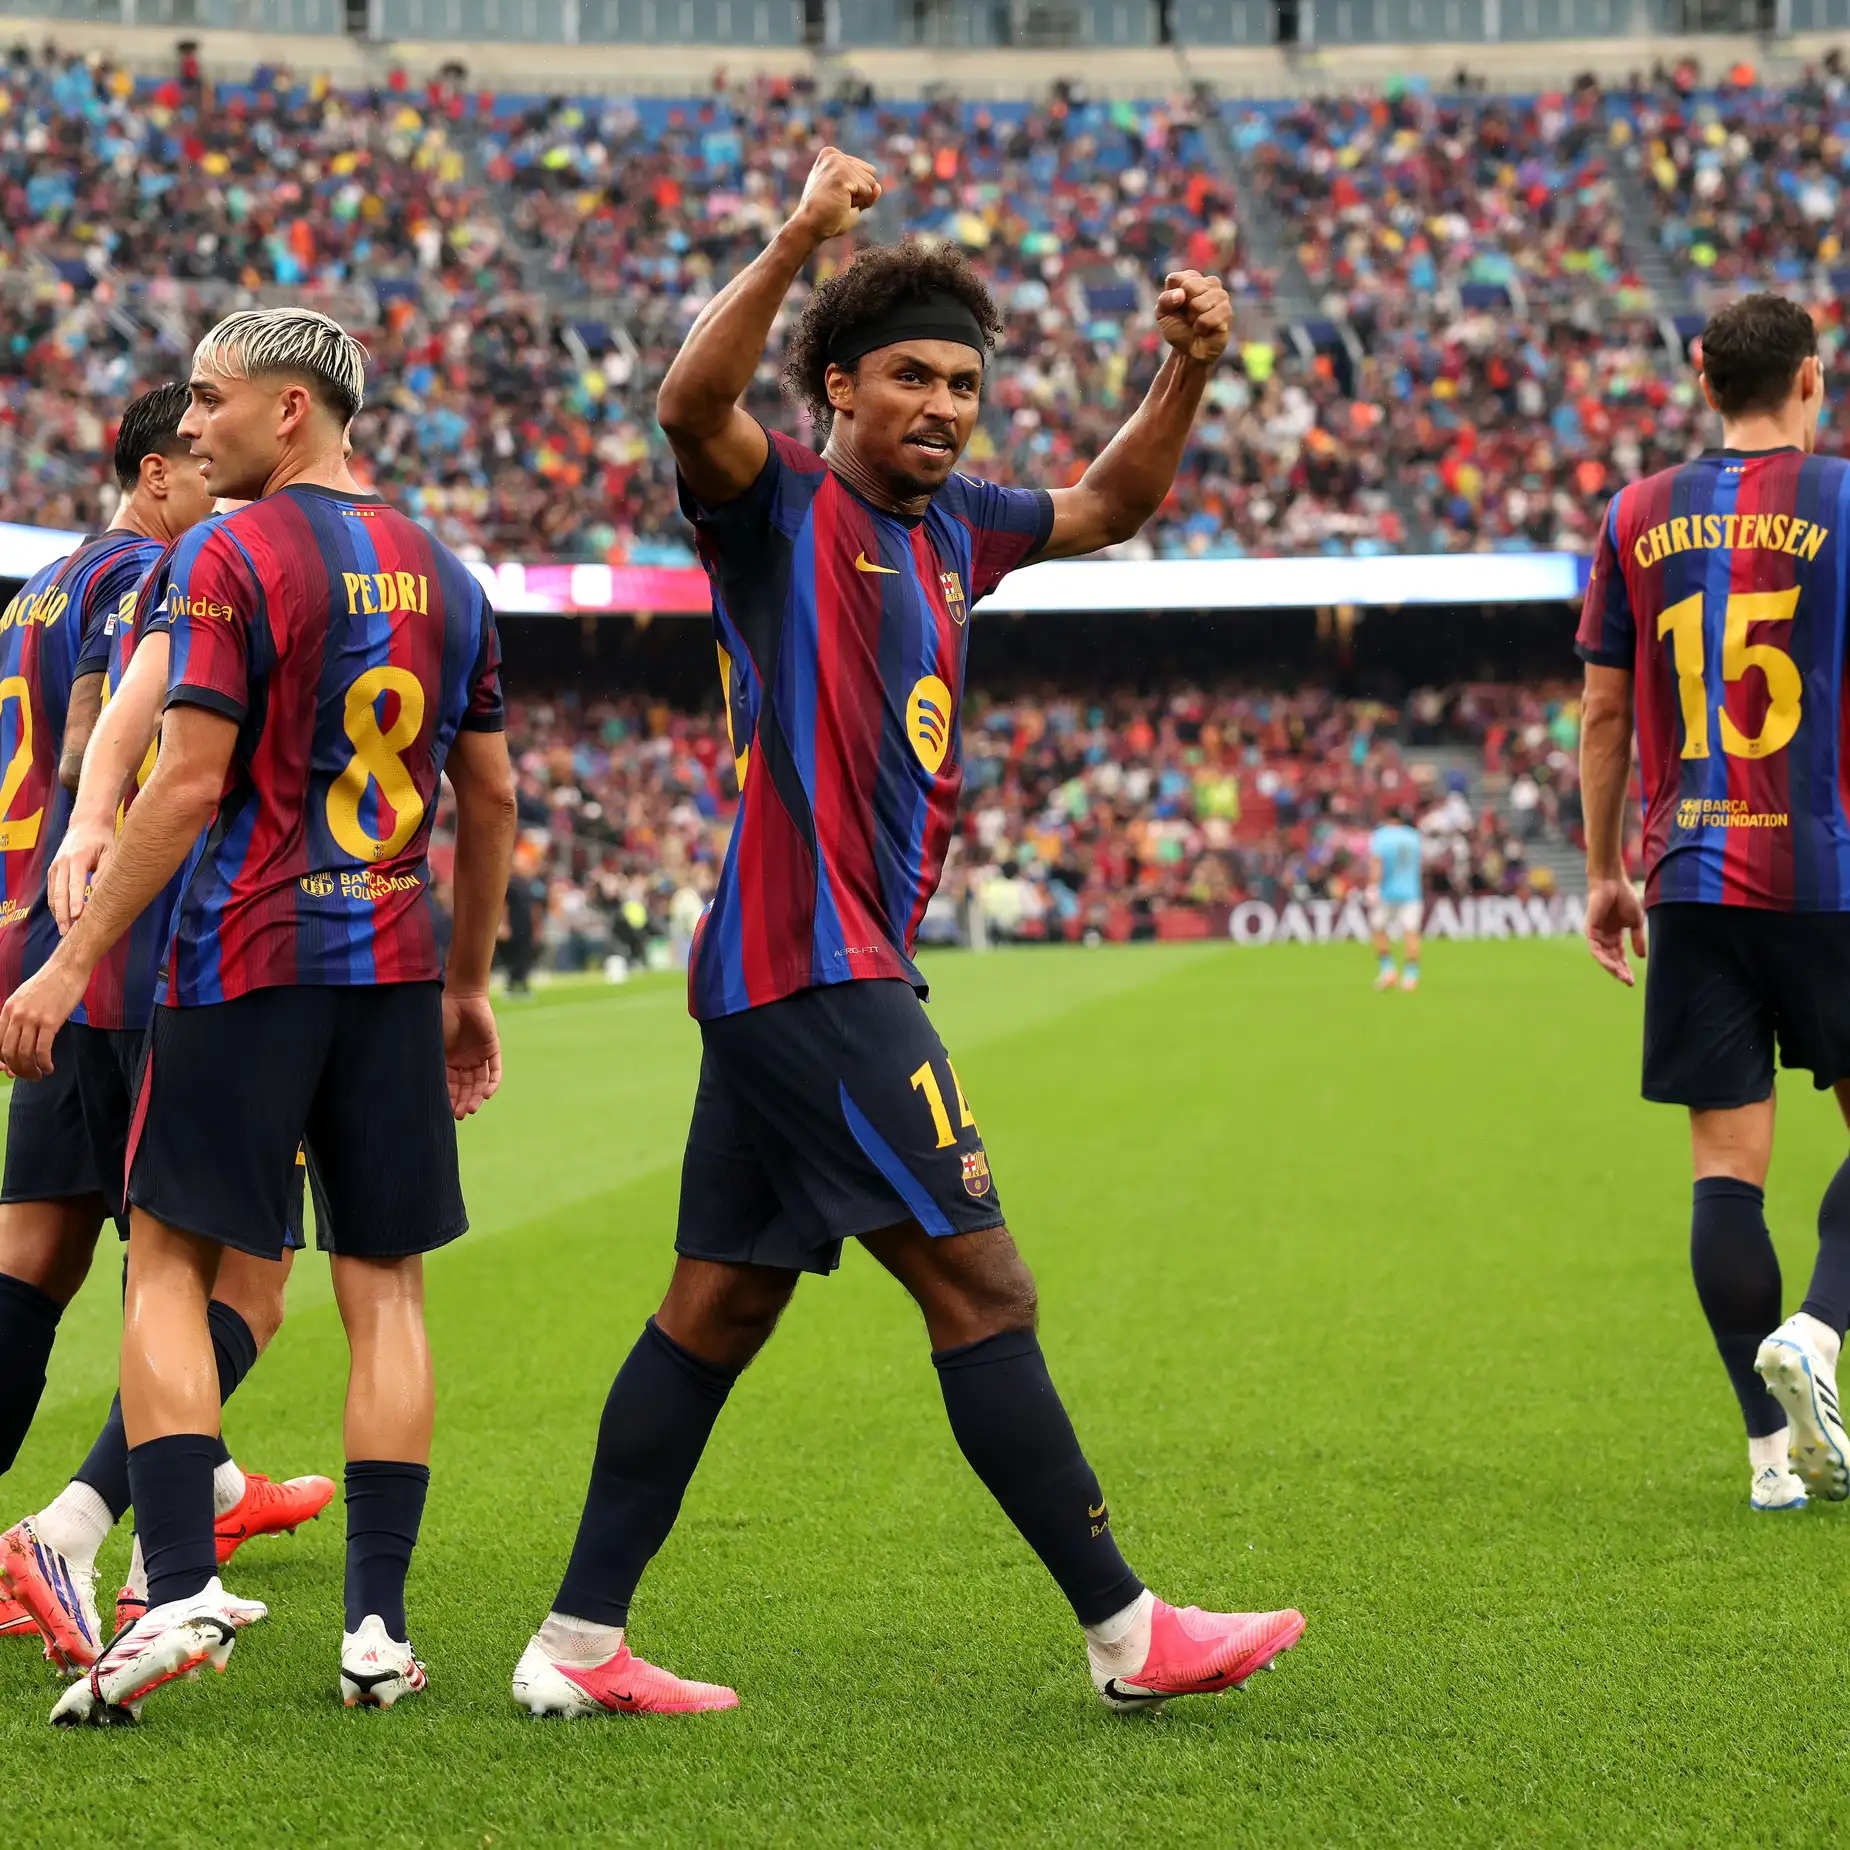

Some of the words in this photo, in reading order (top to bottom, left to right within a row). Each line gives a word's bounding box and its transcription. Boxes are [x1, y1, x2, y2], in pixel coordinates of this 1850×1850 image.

[1634, 514, 1829, 568] CHRISTENSEN
[167, 583, 233, 622] Midea
[342, 571, 428, 616] PEDRI
[1657, 585, 1803, 760] 15
[0, 676, 44, 851] 2
[326, 666, 425, 863] 8
[1702, 800, 1749, 814] BARÇA
[1702, 813, 1788, 828] FOUNDATION
[340, 871, 386, 889] BARÇA
